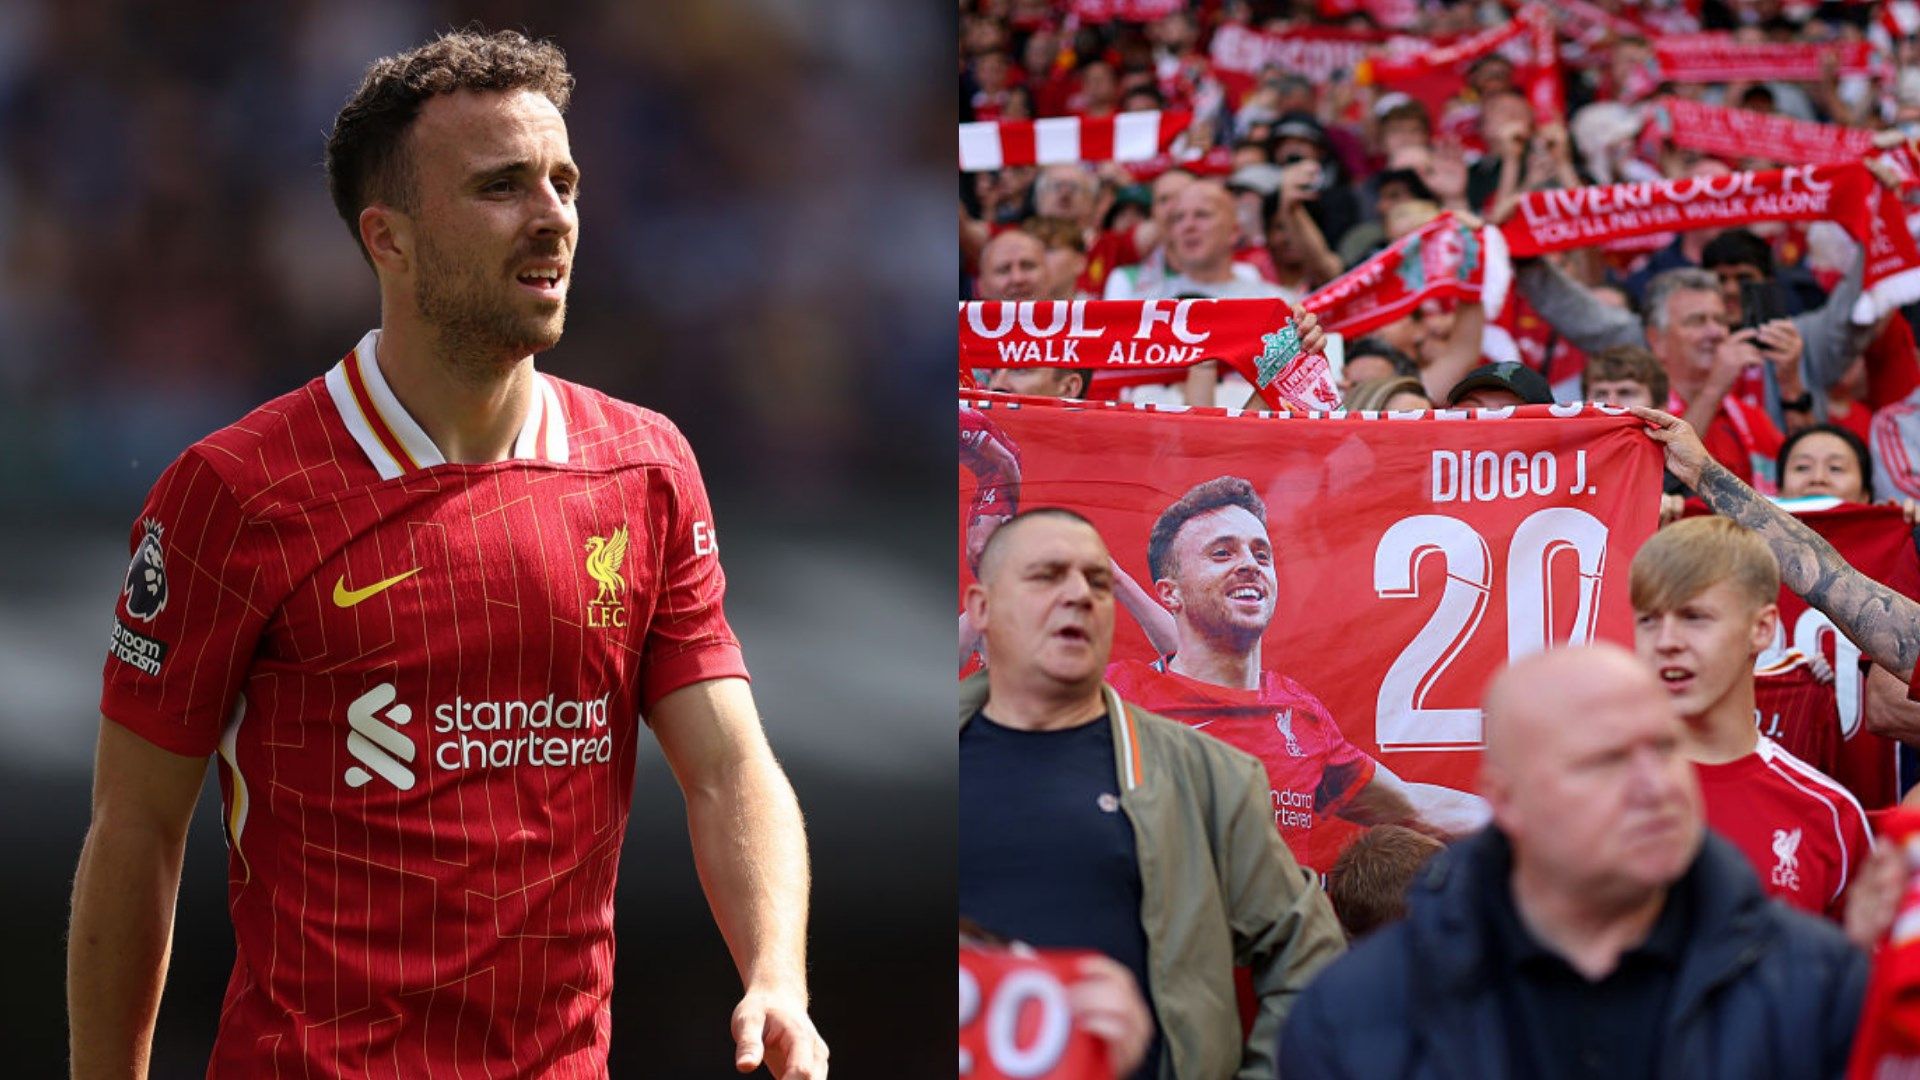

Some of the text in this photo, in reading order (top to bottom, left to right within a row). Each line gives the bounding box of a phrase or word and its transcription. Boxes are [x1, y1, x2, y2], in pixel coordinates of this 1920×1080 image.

[1782, 164, 1833, 193] FC
[1684, 195, 1748, 221] WALK
[1752, 190, 1830, 214] ALONE
[959, 298, 1219, 344] OOL FC
[997, 339, 1081, 363] WALK
[1432, 449, 1598, 502] DIOGO J.
[122, 628, 160, 659] room
[117, 644, 161, 677] racism
[435, 691, 611, 733] standard
[436, 728, 612, 771] chartered
